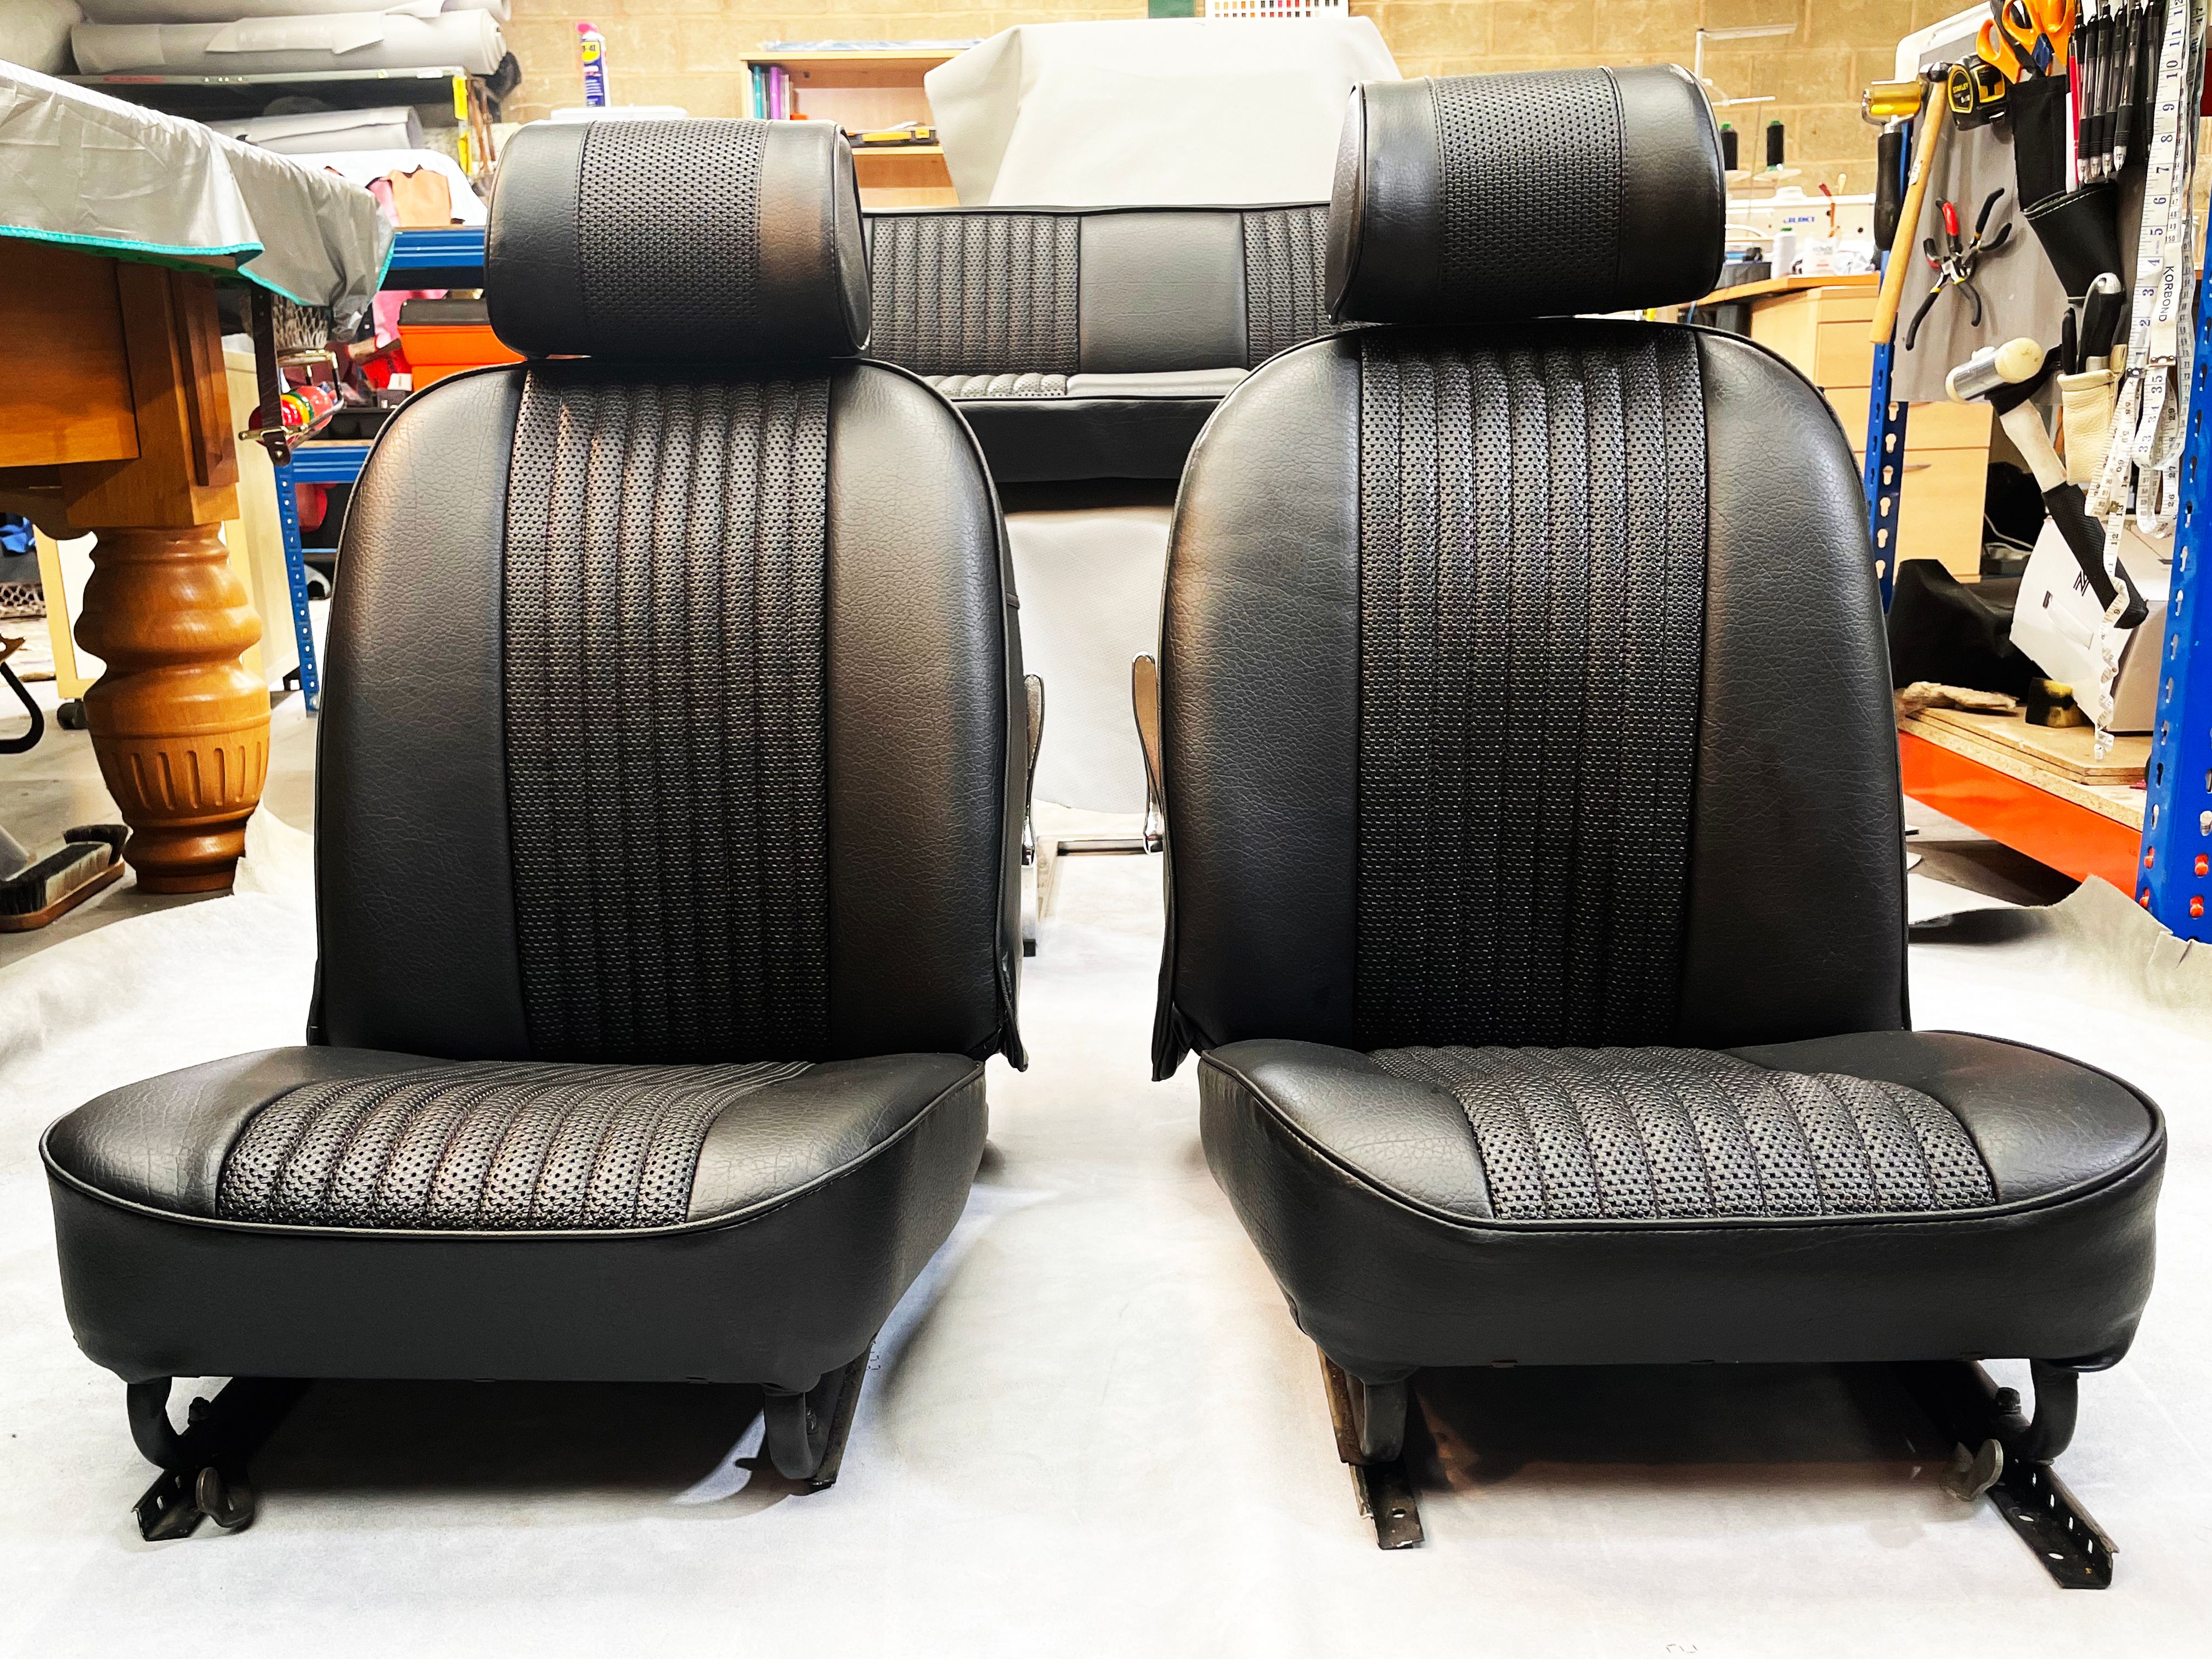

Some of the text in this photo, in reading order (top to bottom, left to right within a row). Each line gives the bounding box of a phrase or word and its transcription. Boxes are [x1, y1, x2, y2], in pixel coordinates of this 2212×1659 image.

[2169, 29, 2181, 47] 11
[2166, 60, 2178, 79] 10
[2160, 134, 2173, 143] 8
[2159, 266, 2175, 322] KORBOND
[2152, 375, 2163, 393] 35
[2138, 435, 2152, 453] 33
[2116, 505, 2124, 517] 13
[2111, 533, 2119, 546] 12
